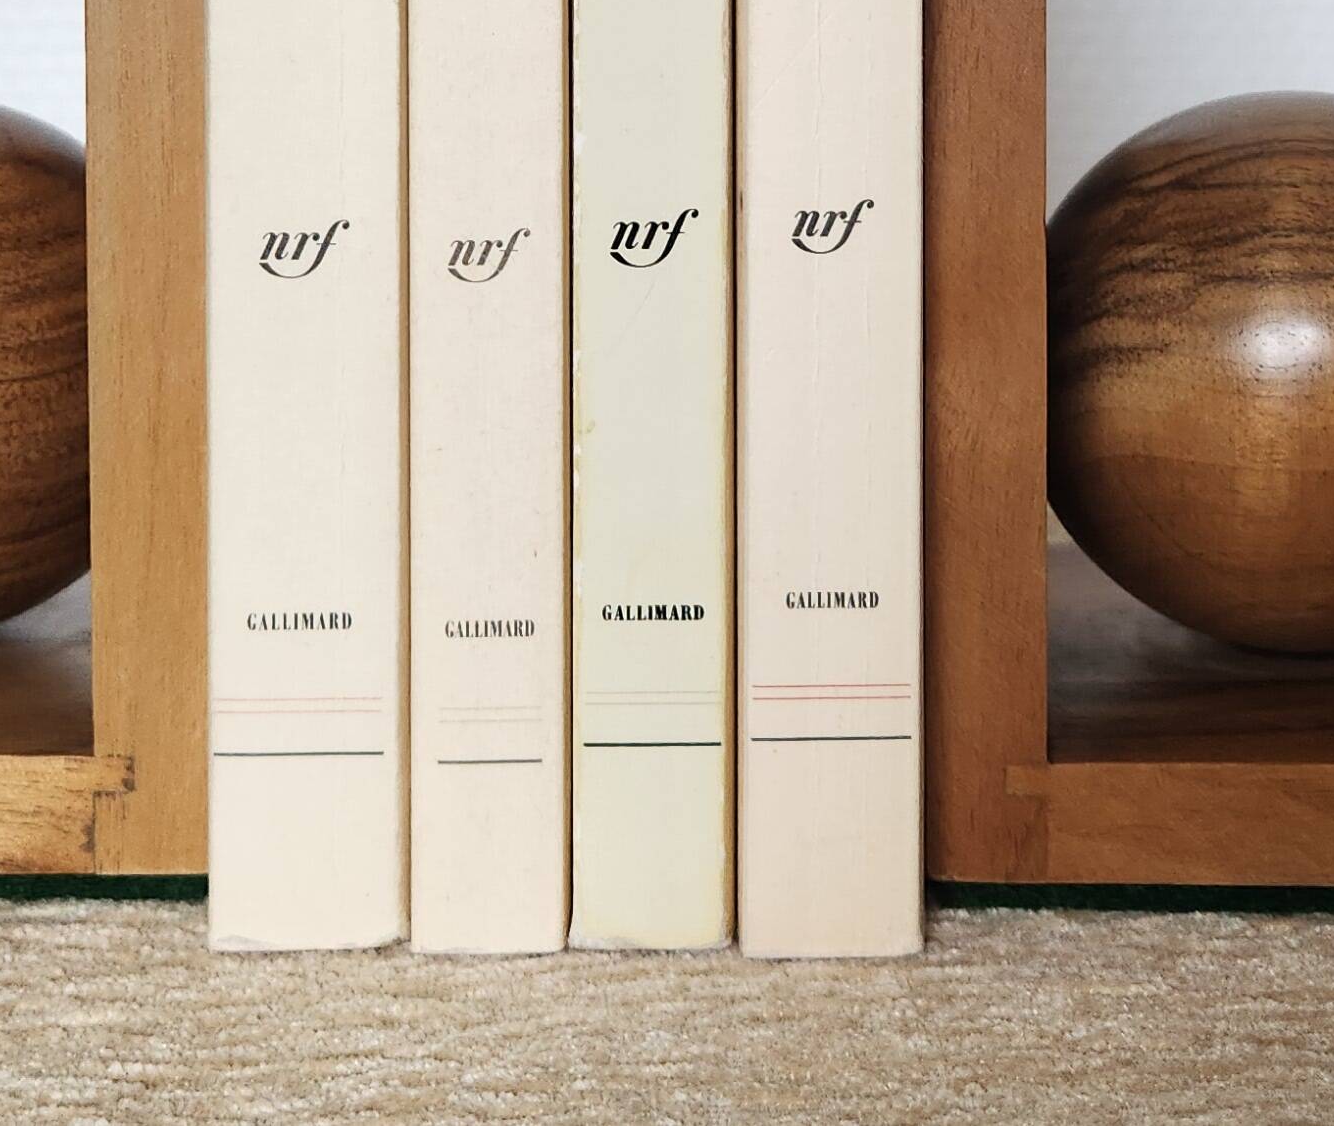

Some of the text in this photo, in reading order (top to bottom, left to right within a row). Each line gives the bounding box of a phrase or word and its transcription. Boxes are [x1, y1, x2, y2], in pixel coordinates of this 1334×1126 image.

[609, 208, 700, 268] nrf
[791, 198, 875, 255] nrf
[259, 219, 351, 279] nrf
[447, 227, 531, 283] nrf
[601, 603, 706, 623] GALLIMARD
[785, 589, 880, 610] GALLIMARD
[246, 611, 353, 632] GALLIMARD
[444, 618, 536, 639] GALLIMARD
